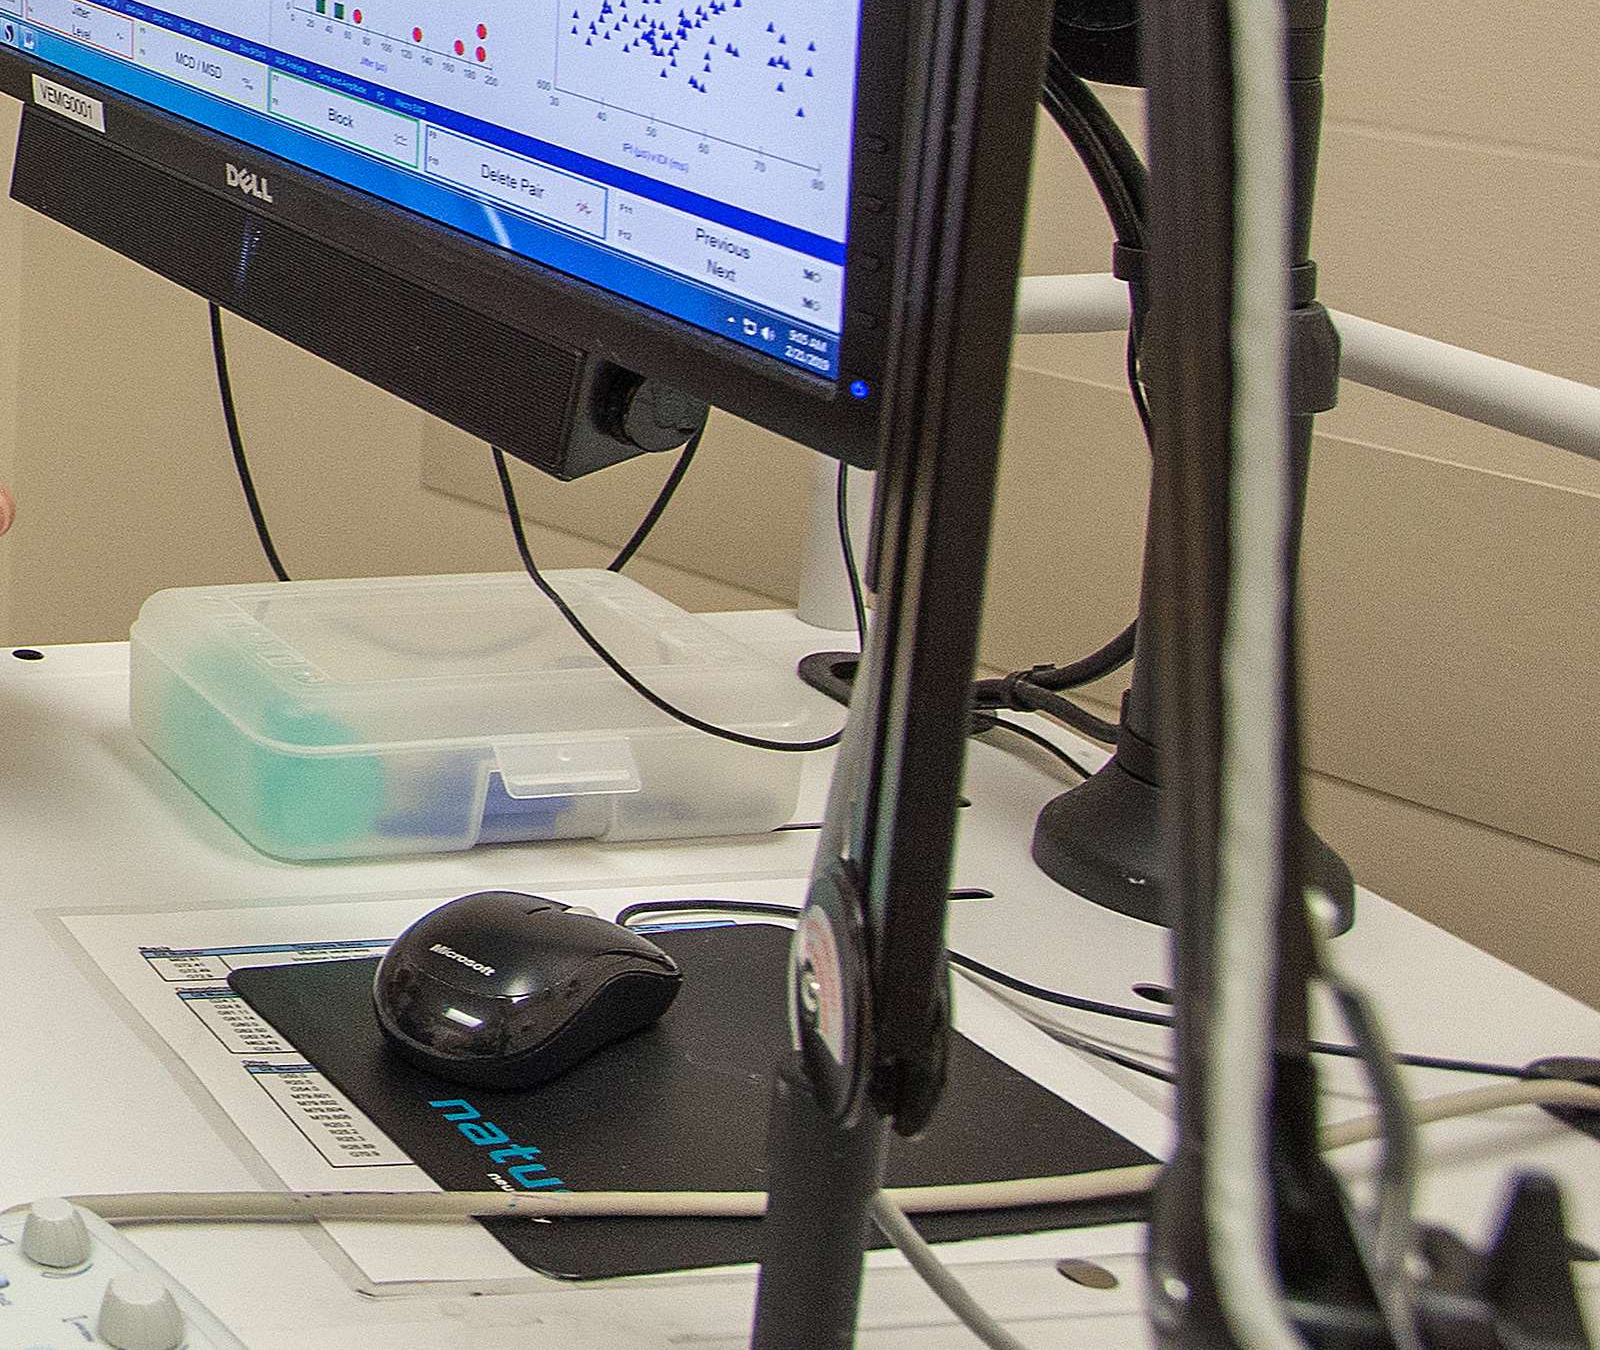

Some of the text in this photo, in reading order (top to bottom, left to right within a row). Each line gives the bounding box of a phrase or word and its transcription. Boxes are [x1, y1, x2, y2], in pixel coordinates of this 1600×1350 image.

[39, 82, 93, 119] VEMG0001
[328, 107, 354, 128] Block
[226, 162, 274, 204] DELL
[480, 163, 545, 200] Delete Pair
[695, 226, 751, 260] Previous
[706, 258, 737, 283] Next
[429, 943, 495, 978] Microsoft
[428, 1099, 568, 1192] natu
